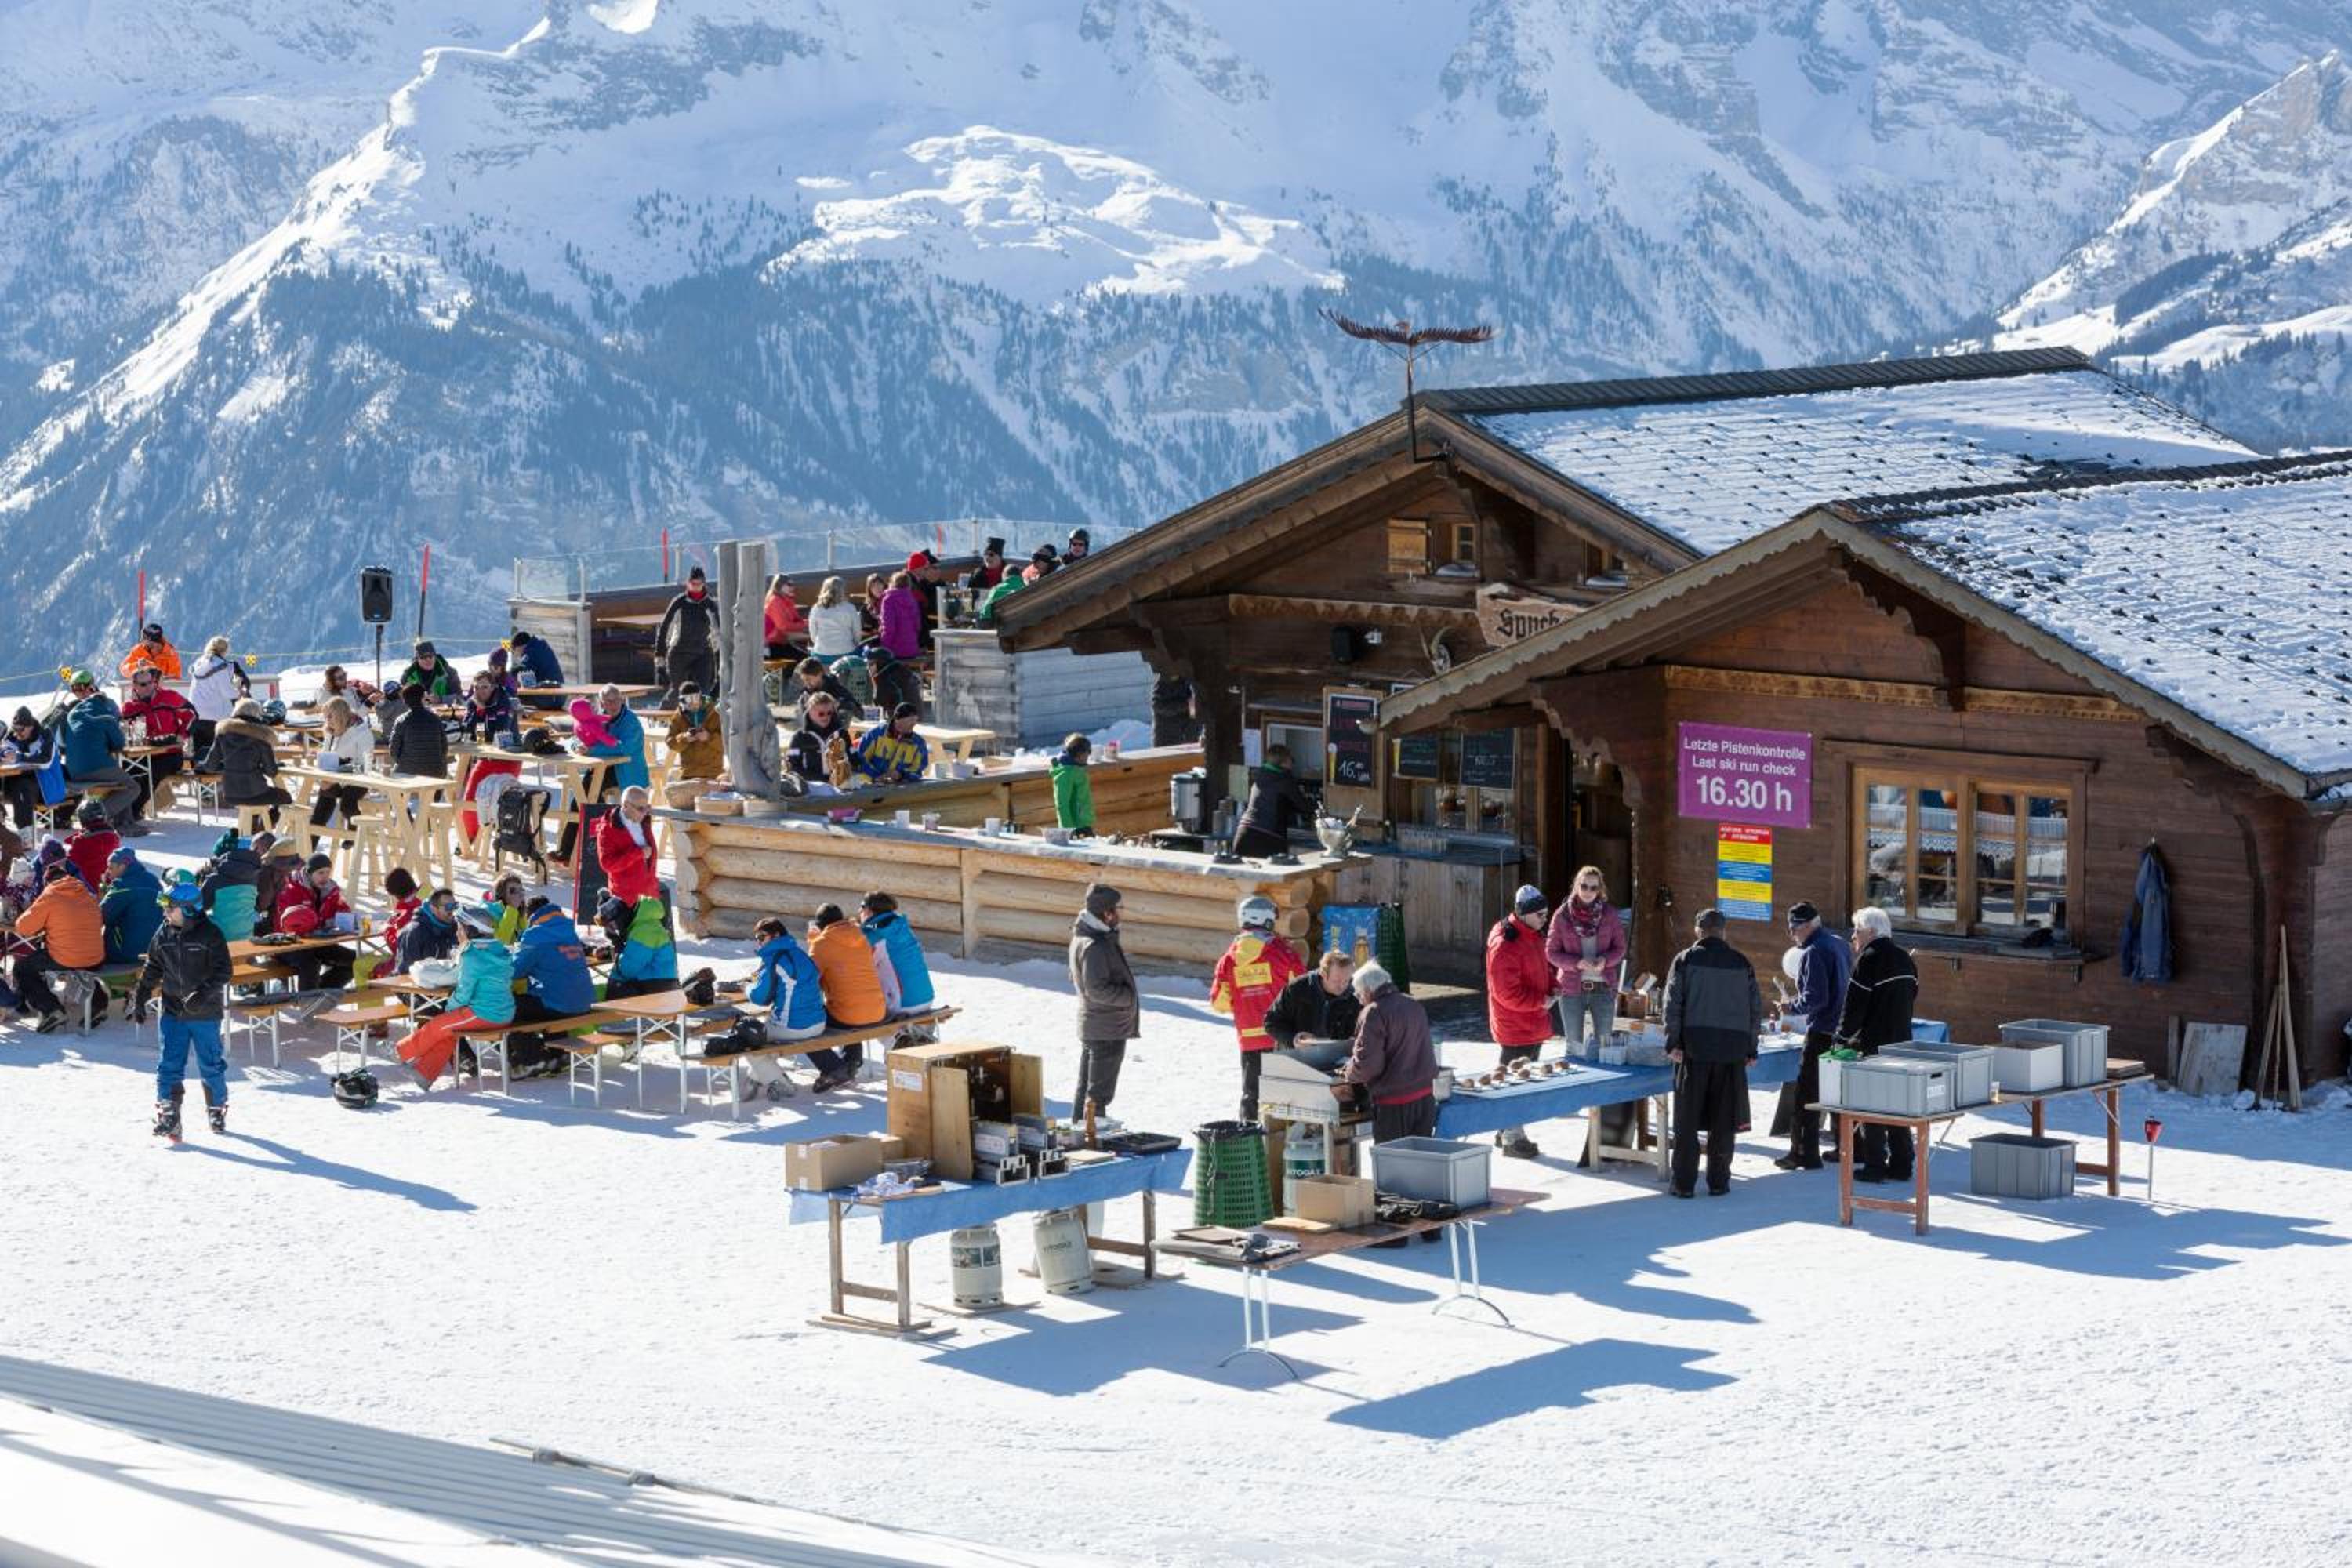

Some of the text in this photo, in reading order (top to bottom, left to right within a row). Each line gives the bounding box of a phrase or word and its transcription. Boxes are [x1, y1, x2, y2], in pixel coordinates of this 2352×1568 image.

[1683, 737, 1806, 760] Letzte Pistenkontrolle
[1693, 755, 1797, 776] Last ski run check
[1696, 775, 1792, 811] 16.30 h
